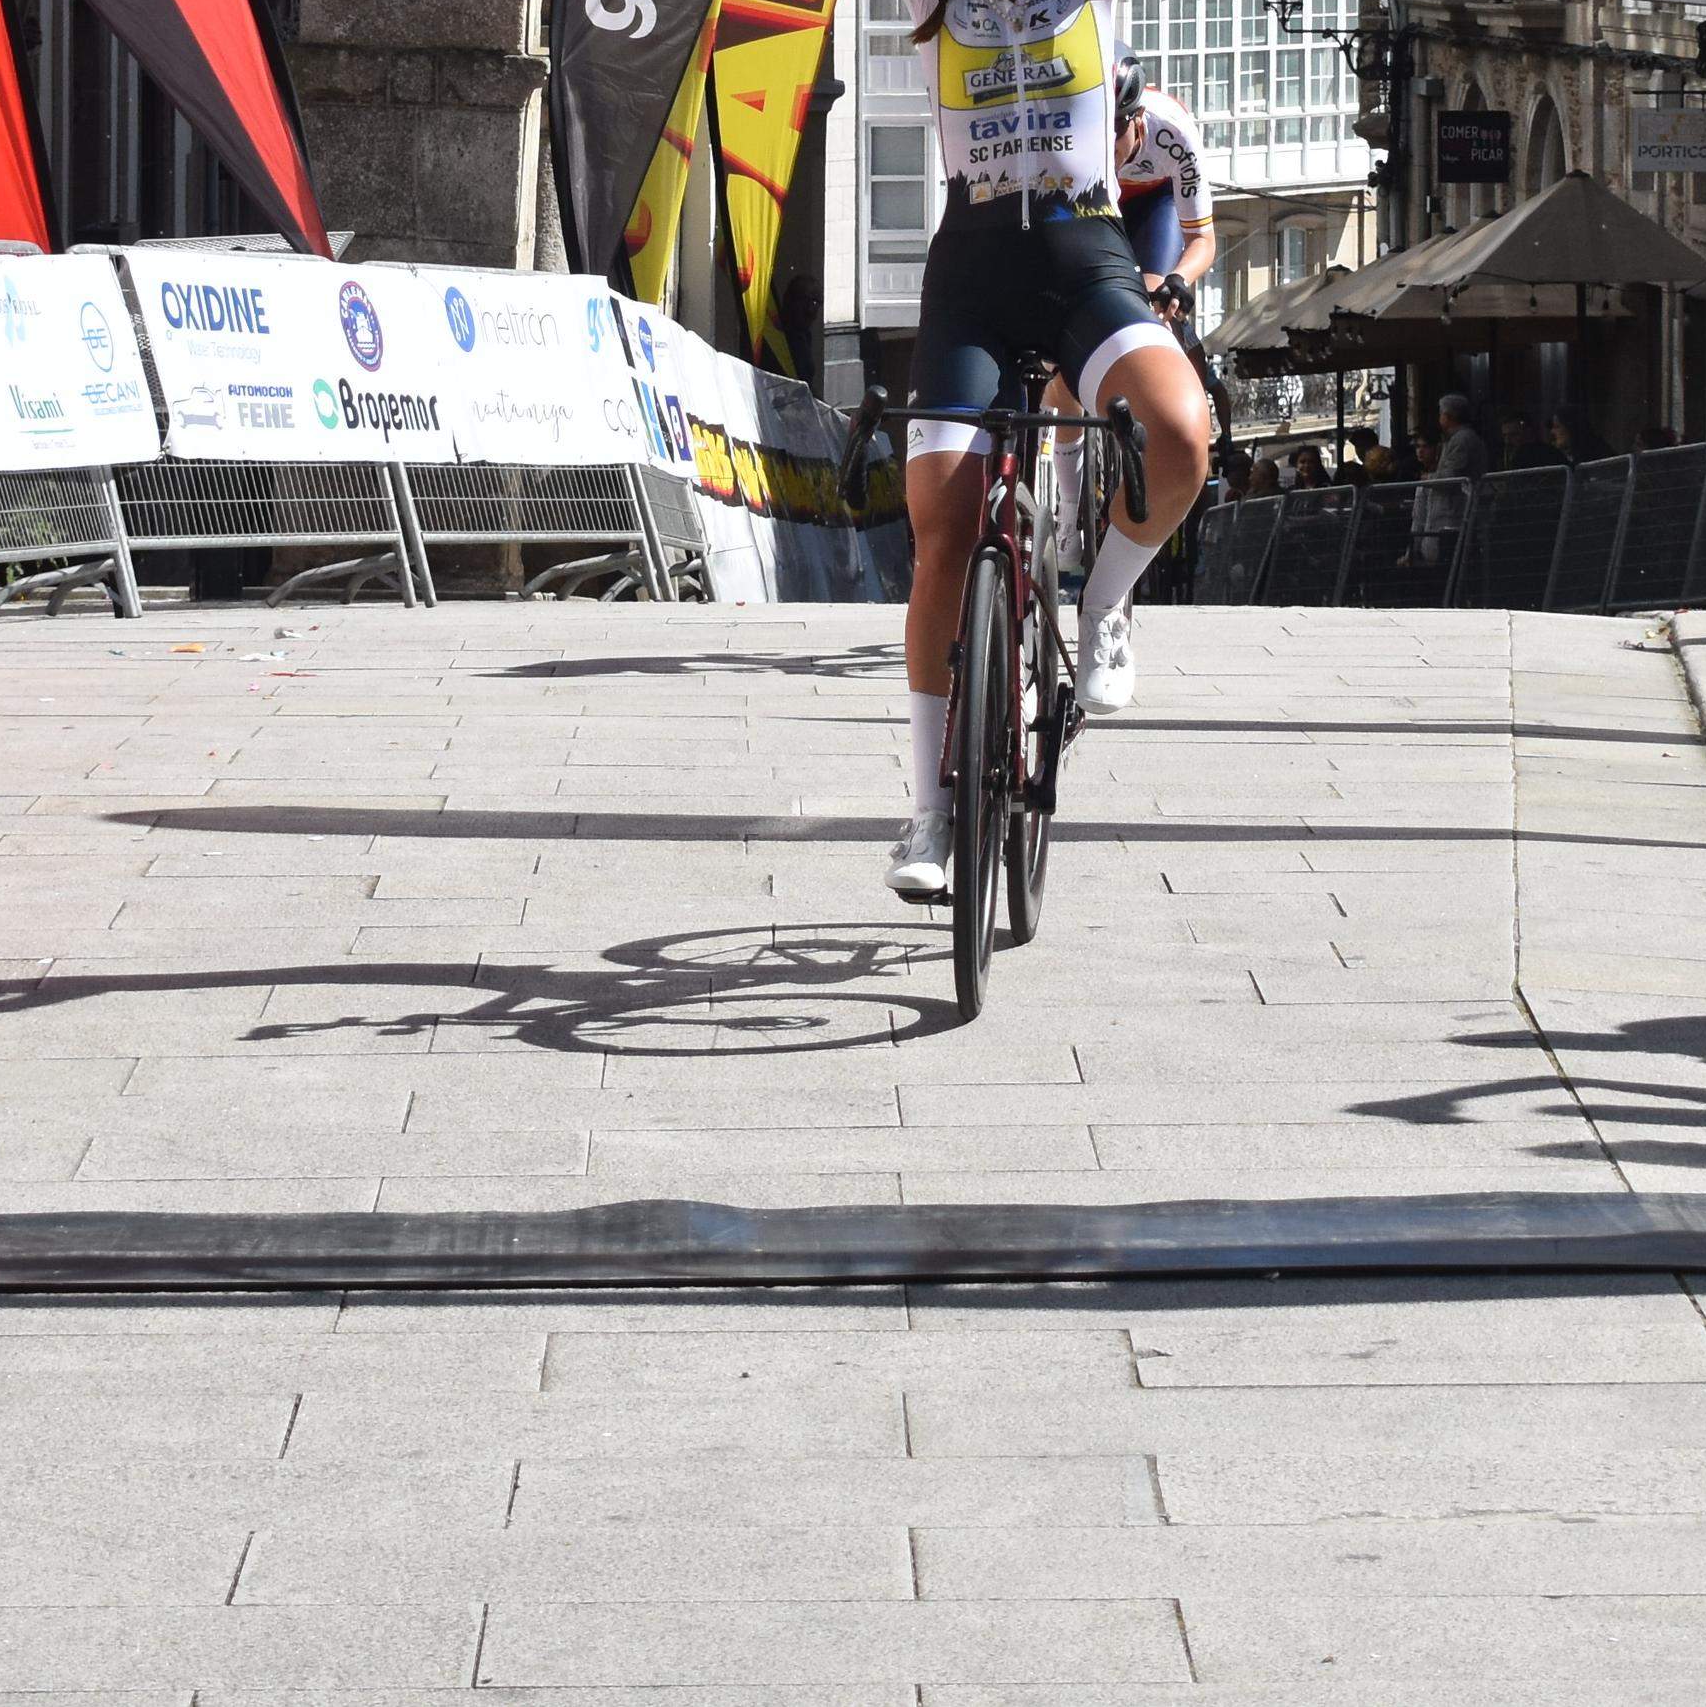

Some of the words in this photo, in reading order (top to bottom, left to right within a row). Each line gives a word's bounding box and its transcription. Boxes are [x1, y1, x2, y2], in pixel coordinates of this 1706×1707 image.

[970, 63, 1061, 89] GENERAL
[969, 108, 1072, 141] tavira
[1441, 125, 1479, 140] COMER
[970, 146, 989, 164] SC
[1155, 128, 1201, 199] Cofidis
[1471, 148, 1504, 162] PICAR
[161, 281, 271, 335] OXIDINE
